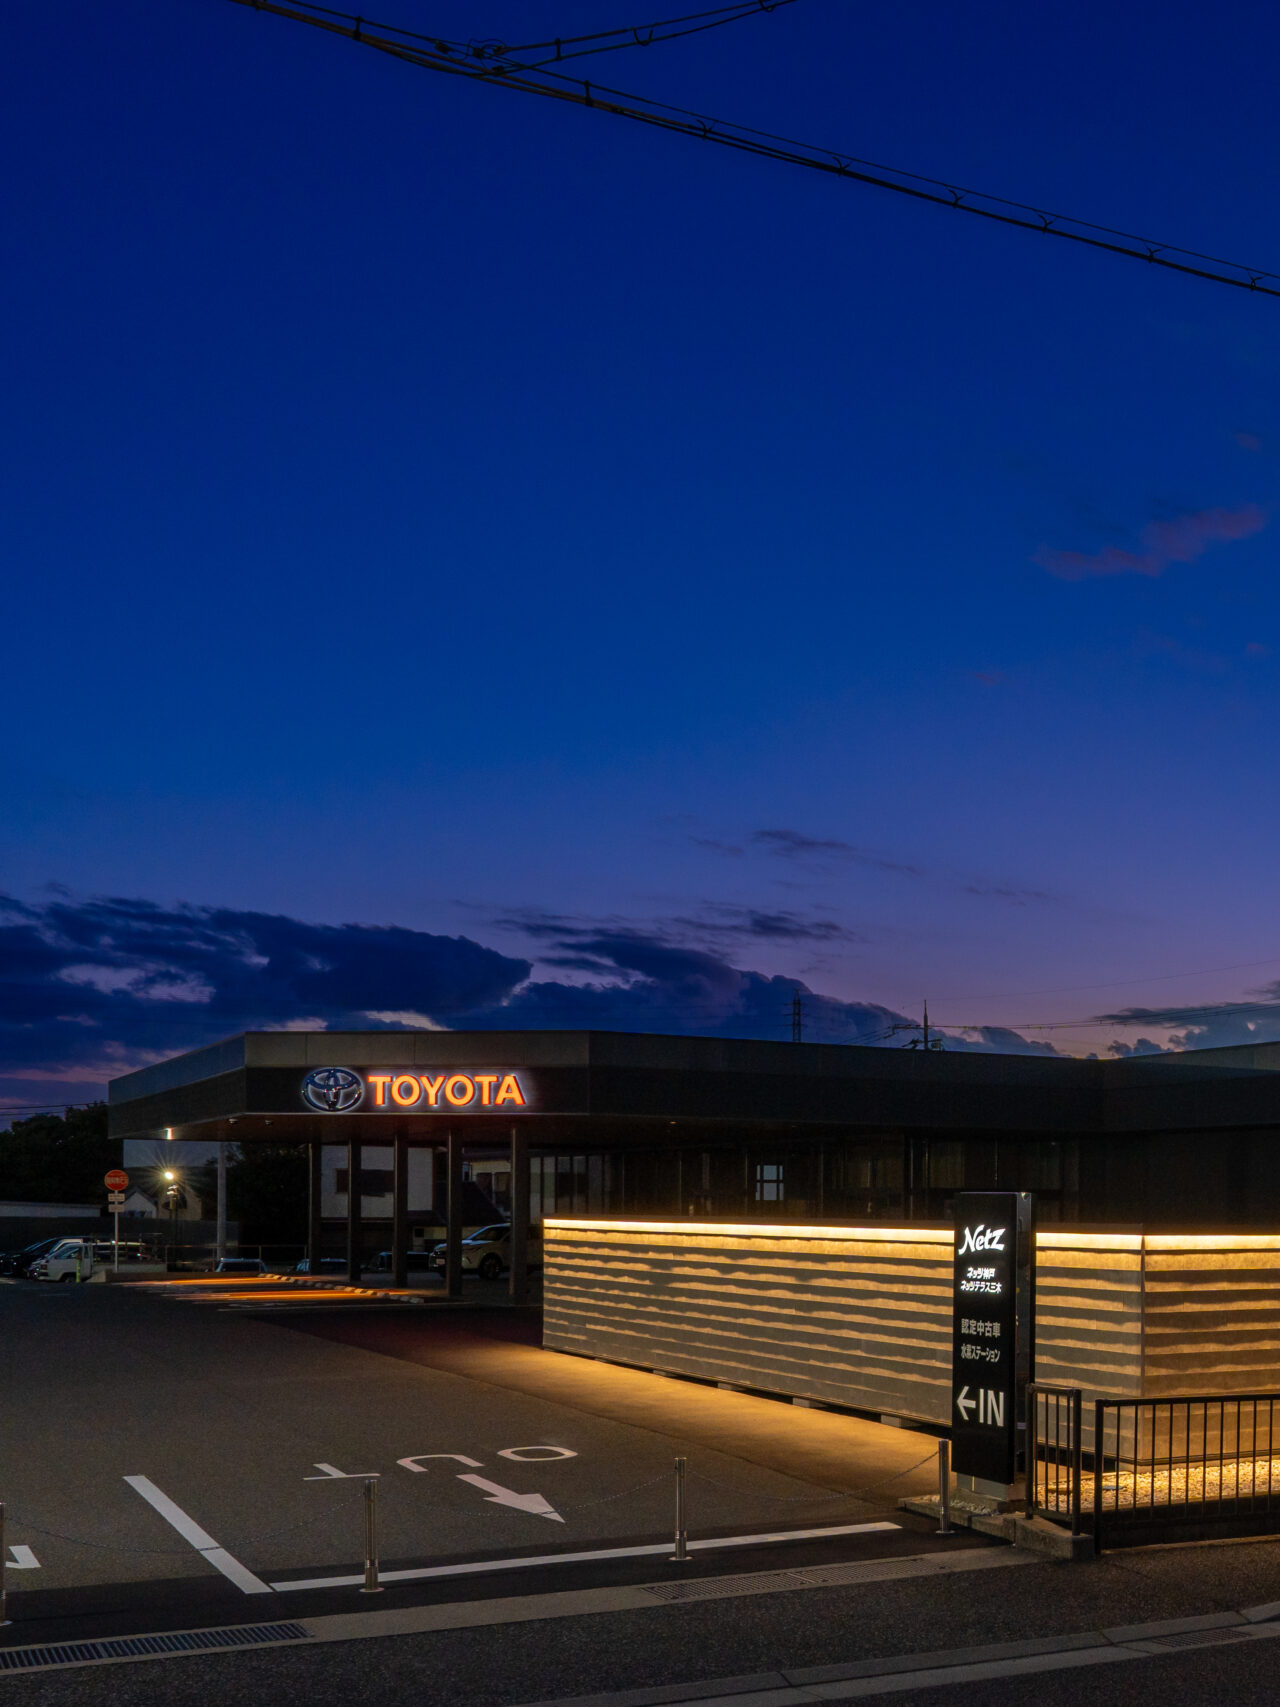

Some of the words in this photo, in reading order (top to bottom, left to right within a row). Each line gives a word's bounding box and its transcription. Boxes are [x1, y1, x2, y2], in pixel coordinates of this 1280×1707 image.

[368, 1074, 526, 1107] TOYOTA
[958, 1224, 1006, 1256] Netz
[960, 1318, 1001, 1338] 認定中古車
[960, 1343, 1001, 1363] 水素ステーション
[979, 1388, 1004, 1427] IN
